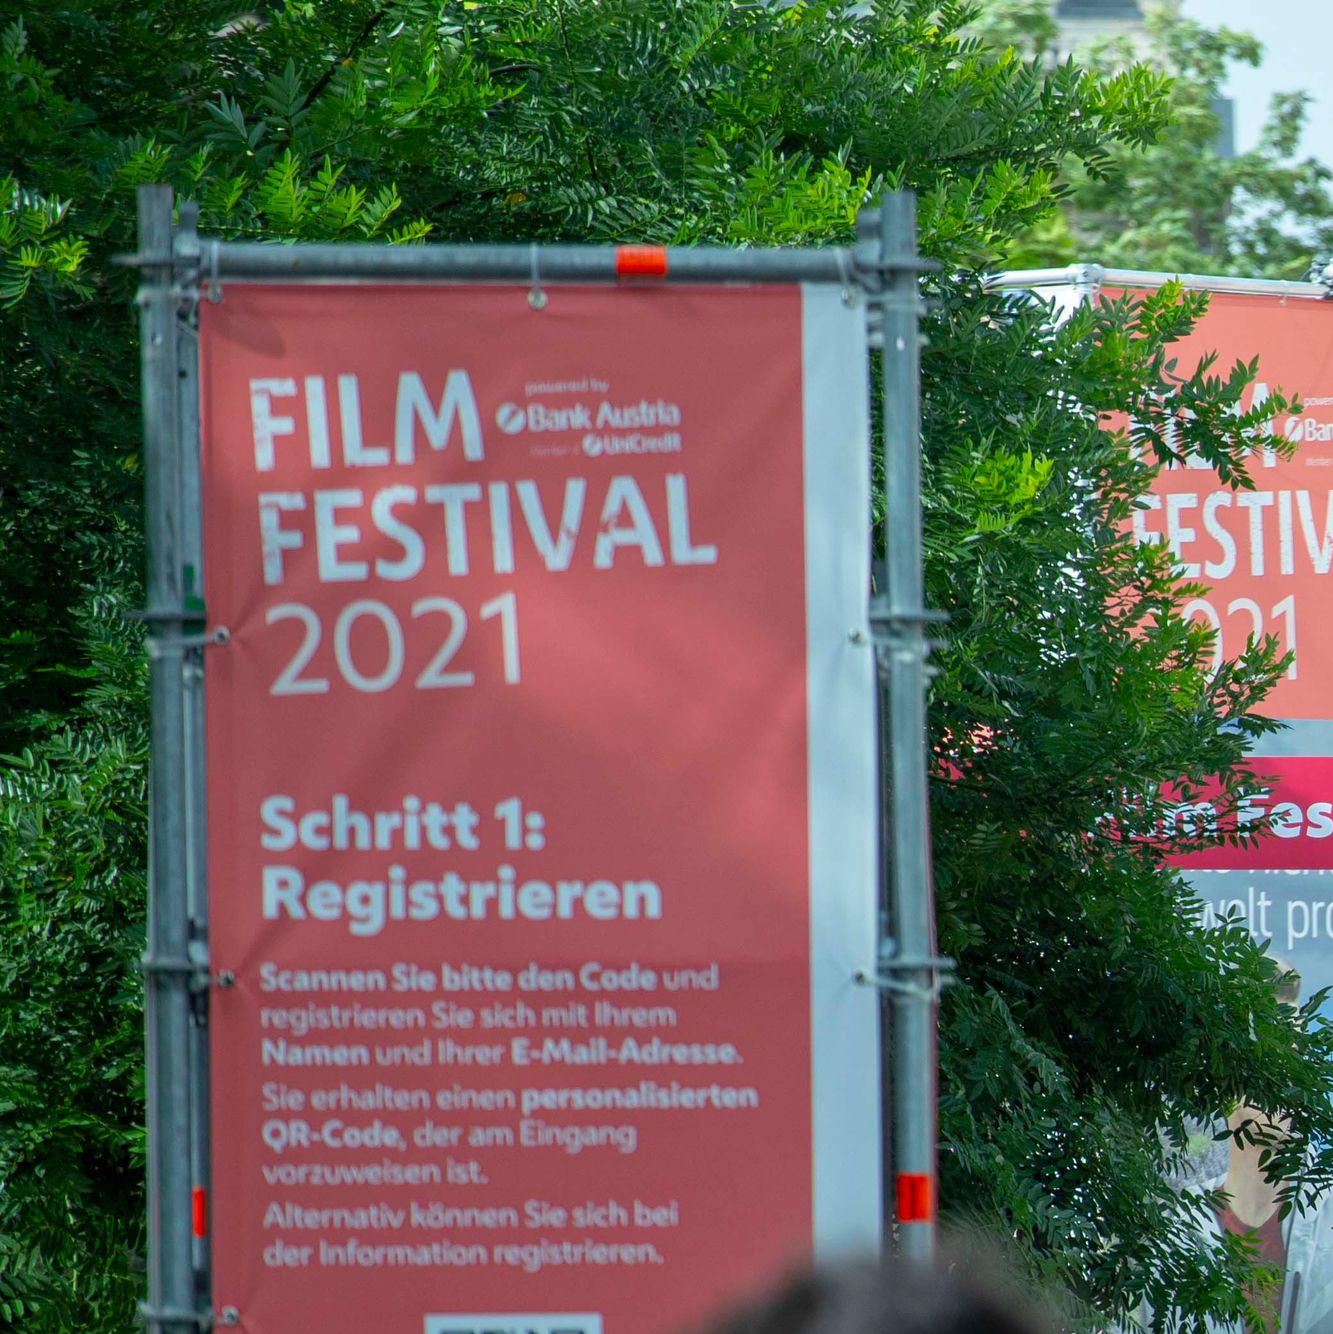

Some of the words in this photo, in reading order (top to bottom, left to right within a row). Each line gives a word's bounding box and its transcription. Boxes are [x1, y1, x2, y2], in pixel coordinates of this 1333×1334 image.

[250, 369, 484, 471] FILM
[527, 402, 592, 432] Bank
[597, 398, 681, 429] Austria
[258, 473, 717, 585] FESTIVAL
[264, 592, 520, 695] 2021
[260, 794, 478, 850] Schritt
[495, 797, 546, 850] 1:
[261, 865, 663, 935] Registrieren
[260, 962, 386, 992] Scannen
[392, 961, 436, 992] Sie
[442, 962, 514, 992] bitte
[517, 961, 575, 991] den
[580, 961, 657, 991] Code
[663, 961, 719, 991] und
[260, 1001, 426, 1036] registrieren
[432, 1000, 475, 1028] Sie
[480, 1000, 536, 1027] sich
[542, 1002, 589, 1027] mit
[595, 1001, 677, 1027] Ihrem
[261, 1037, 370, 1066] Namen
[375, 1037, 433, 1066] und
[438, 1037, 505, 1066] Ihrer
[511, 1036, 744, 1065] E-Mail-Adresse.
[262, 1081, 306, 1111] Sie
[311, 1081, 431, 1111] erhalten
[436, 1084, 515, 1110] einen
[521, 1080, 759, 1117] personalisierten
[262, 1118, 407, 1153] QR-Code,
[413, 1120, 463, 1148] der
[468, 1126, 514, 1147] am
[519, 1119, 638, 1154] Eingang
[262, 1156, 441, 1185] vorzuweisen
[446, 1156, 489, 1184] ist.
[263, 1201, 405, 1229] Alternativ
[410, 1200, 518, 1229] können
[524, 1199, 568, 1228] Sie
[572, 1199, 629, 1228] sich
[634, 1199, 679, 1227] bei
[263, 1239, 313, 1267] der
[319, 1237, 488, 1266] Information
[494, 1238, 665, 1273] registrieren.
